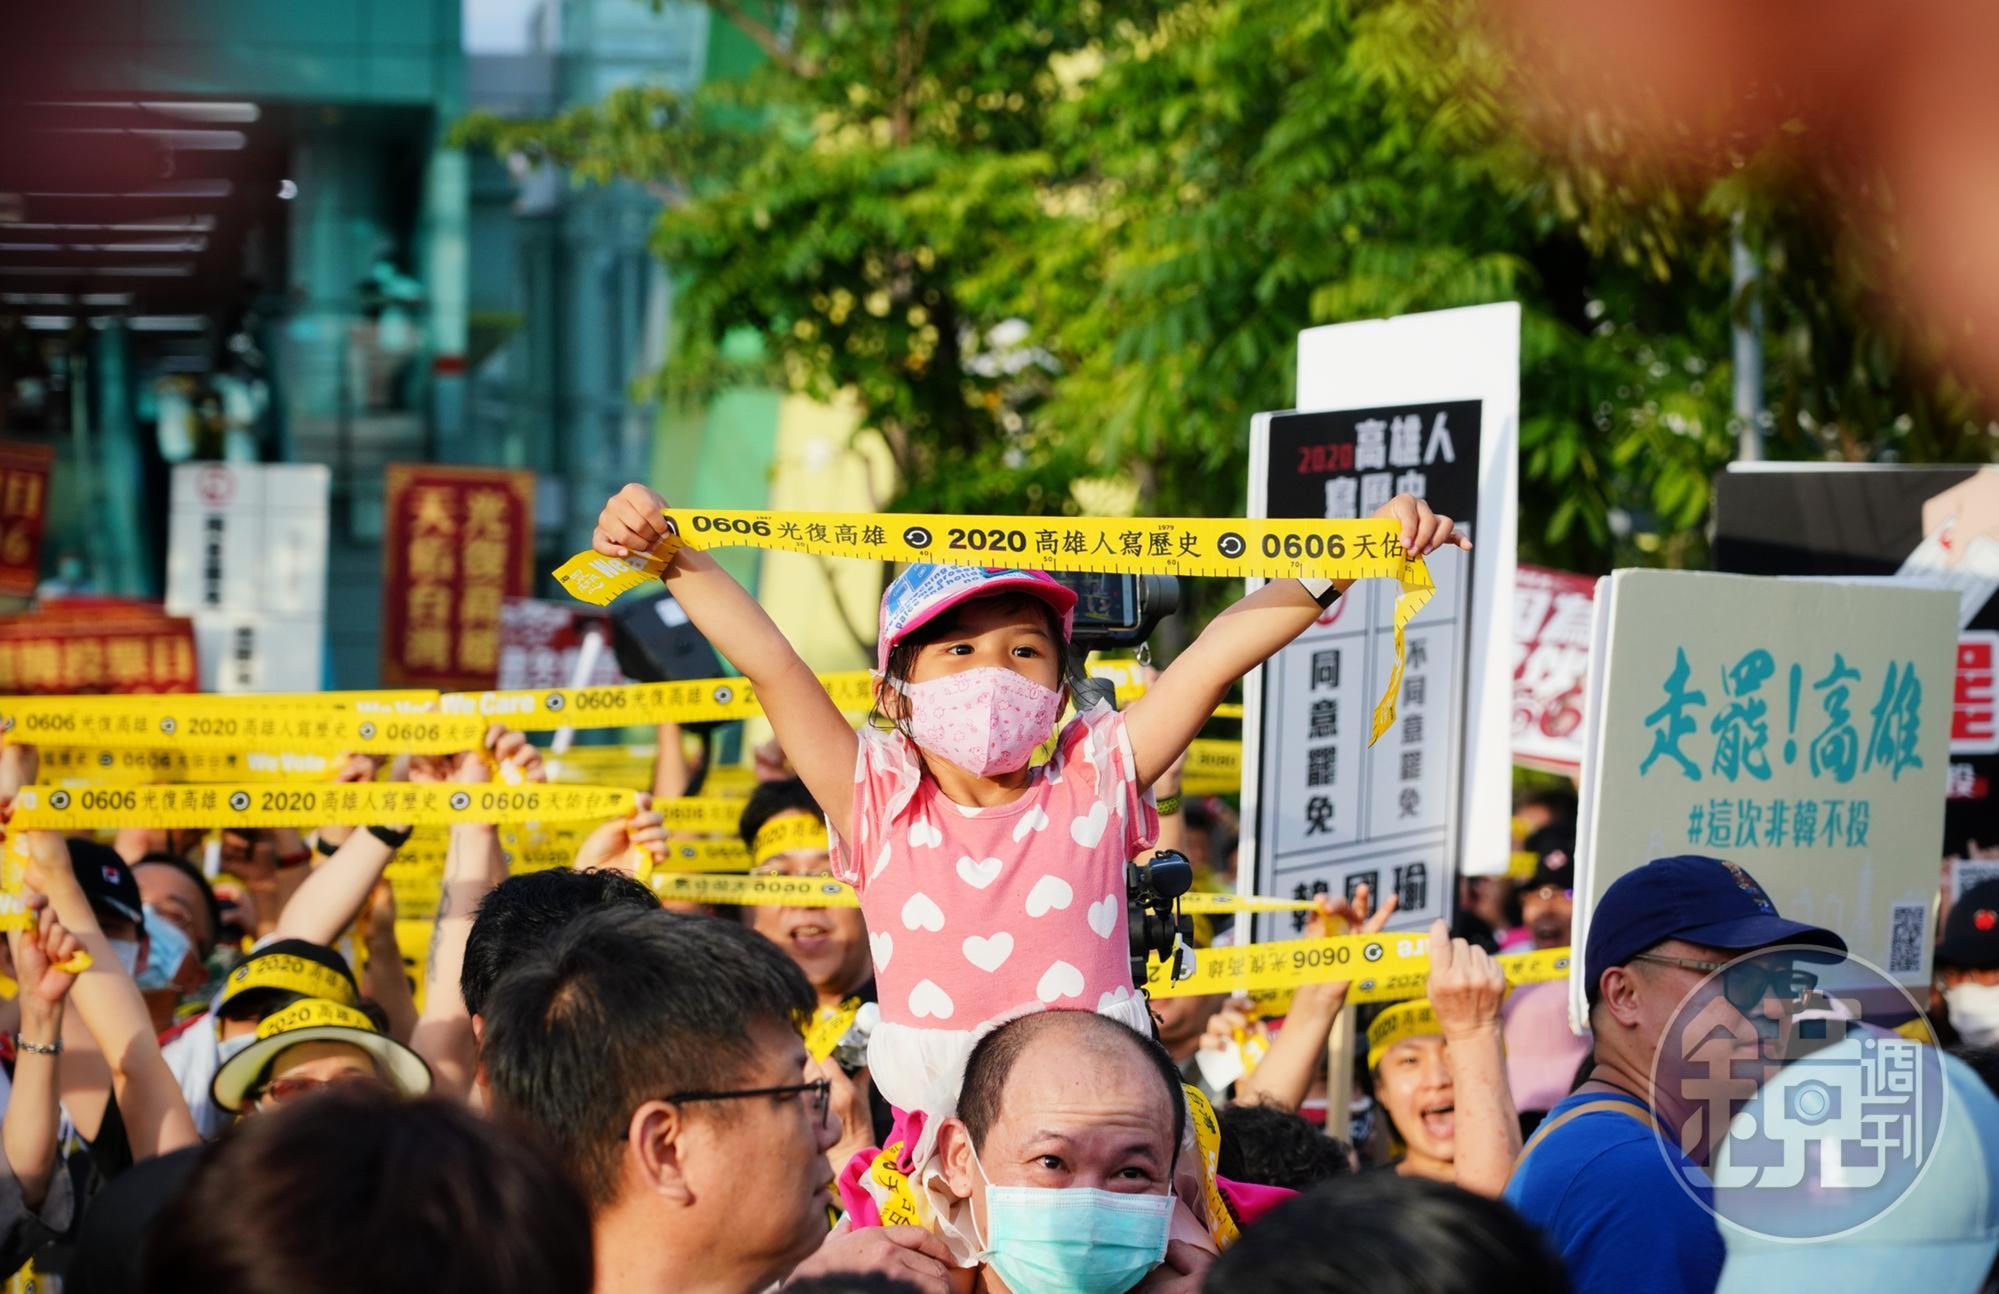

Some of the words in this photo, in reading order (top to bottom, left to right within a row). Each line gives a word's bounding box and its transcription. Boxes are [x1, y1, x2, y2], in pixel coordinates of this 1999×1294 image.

[692, 515, 771, 537] 0606
[777, 521, 887, 546] 光復高雄
[947, 528, 1027, 553] 2020
[1035, 529, 1202, 559] 高雄人寫歷史
[1261, 533, 1346, 559] 0606
[441, 691, 477, 715] We
[481, 691, 536, 716] Care
[575, 690, 627, 711] 0606
[26, 713, 76, 732] 0606
[188, 717, 238, 736] 2020
[386, 722, 440, 741] 0606
[1306, 648, 1341, 837] 同意罷免
[1397, 636, 1428, 820] 不同意罷免
[81, 790, 137, 810] 0606
[142, 789, 218, 812] 光復高雄
[261, 791, 316, 811] 2020
[322, 789, 438, 813] 高雄人寫歷史
[481, 792, 540, 811] 0606
[1687, 799, 1870, 848] #這次非韓不投
[1293, 945, 1350, 970] 0606
